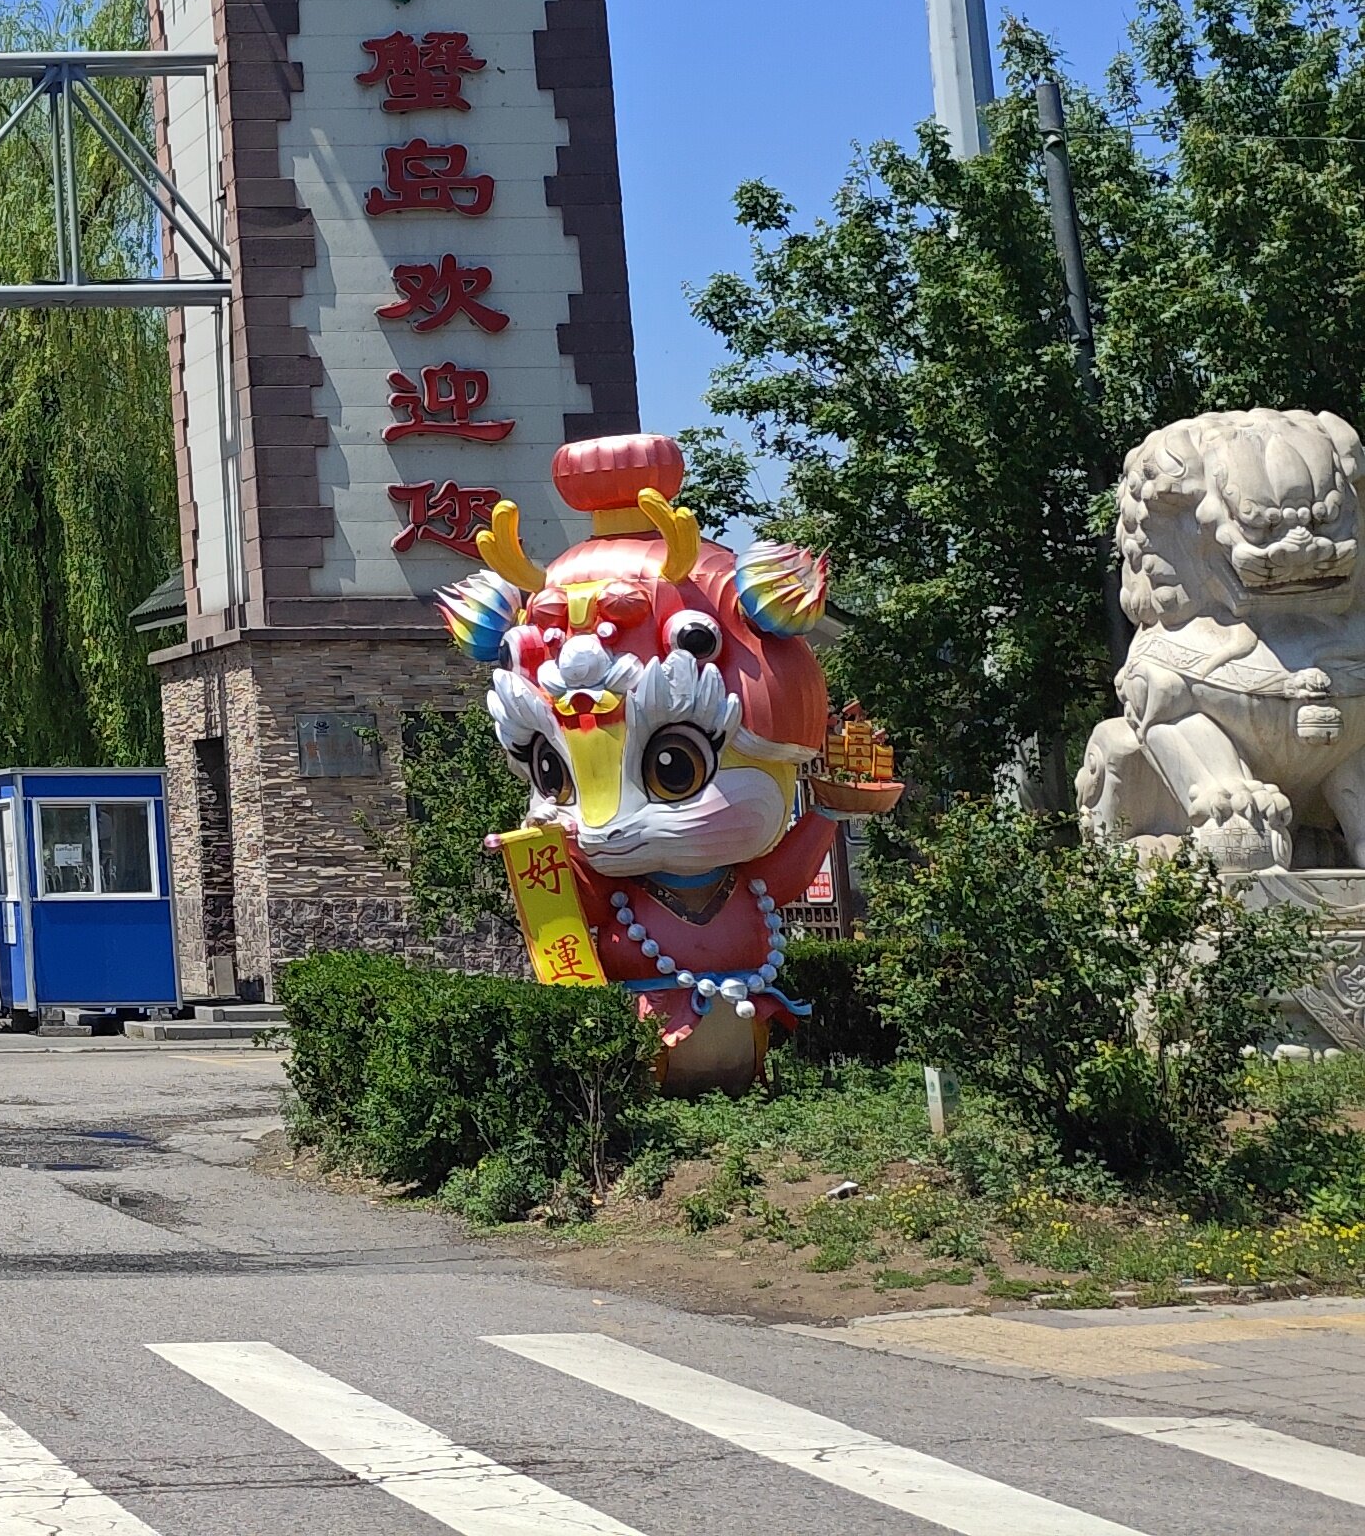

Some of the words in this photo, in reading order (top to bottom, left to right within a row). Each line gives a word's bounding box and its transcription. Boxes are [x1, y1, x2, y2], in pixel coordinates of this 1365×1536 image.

[356, 30, 523, 562] 蟹岛欢迎您
[518, 844, 596, 985] 好運
